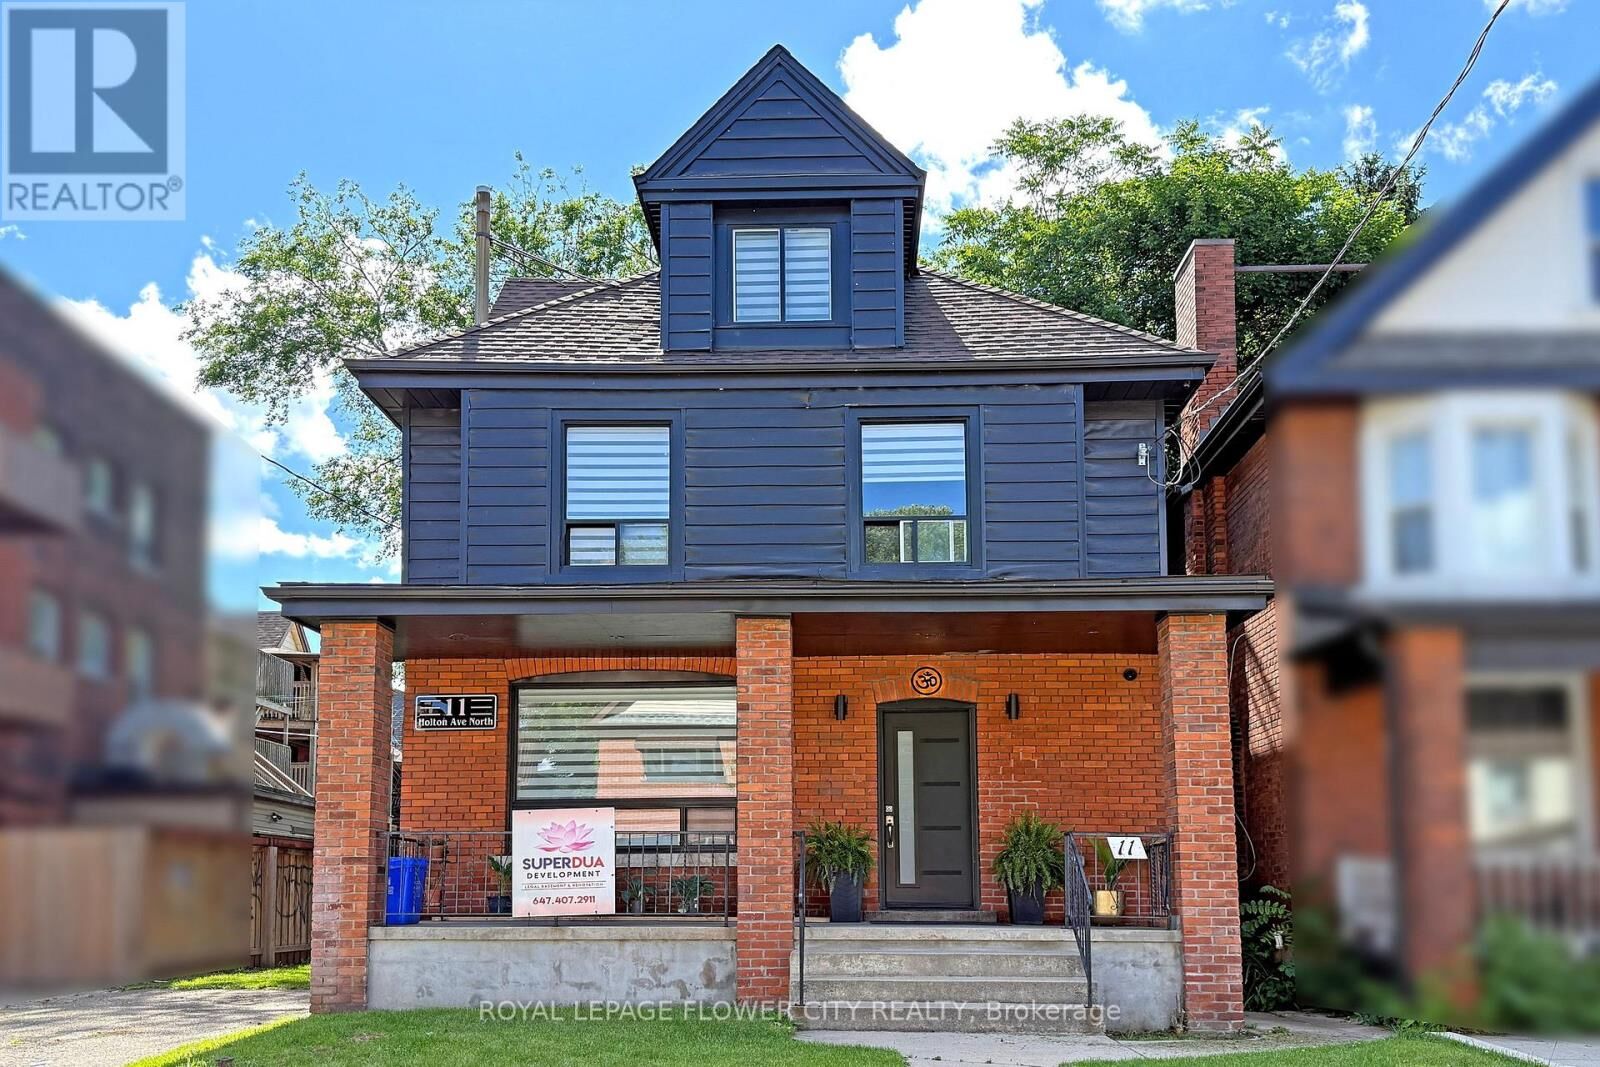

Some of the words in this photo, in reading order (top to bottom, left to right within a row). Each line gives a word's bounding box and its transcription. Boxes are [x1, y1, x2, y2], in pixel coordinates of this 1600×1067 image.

[446, 698, 465, 716] 11
[418, 718, 448, 727] Holton
[450, 718, 467, 726] Ave
[469, 717, 493, 726] North
[1118, 840, 1135, 855] 11
[522, 856, 605, 870] SUPERDUA
[526, 871, 601, 879] DEVELOPMENT
[533, 896, 596, 905] 647.407.2911
